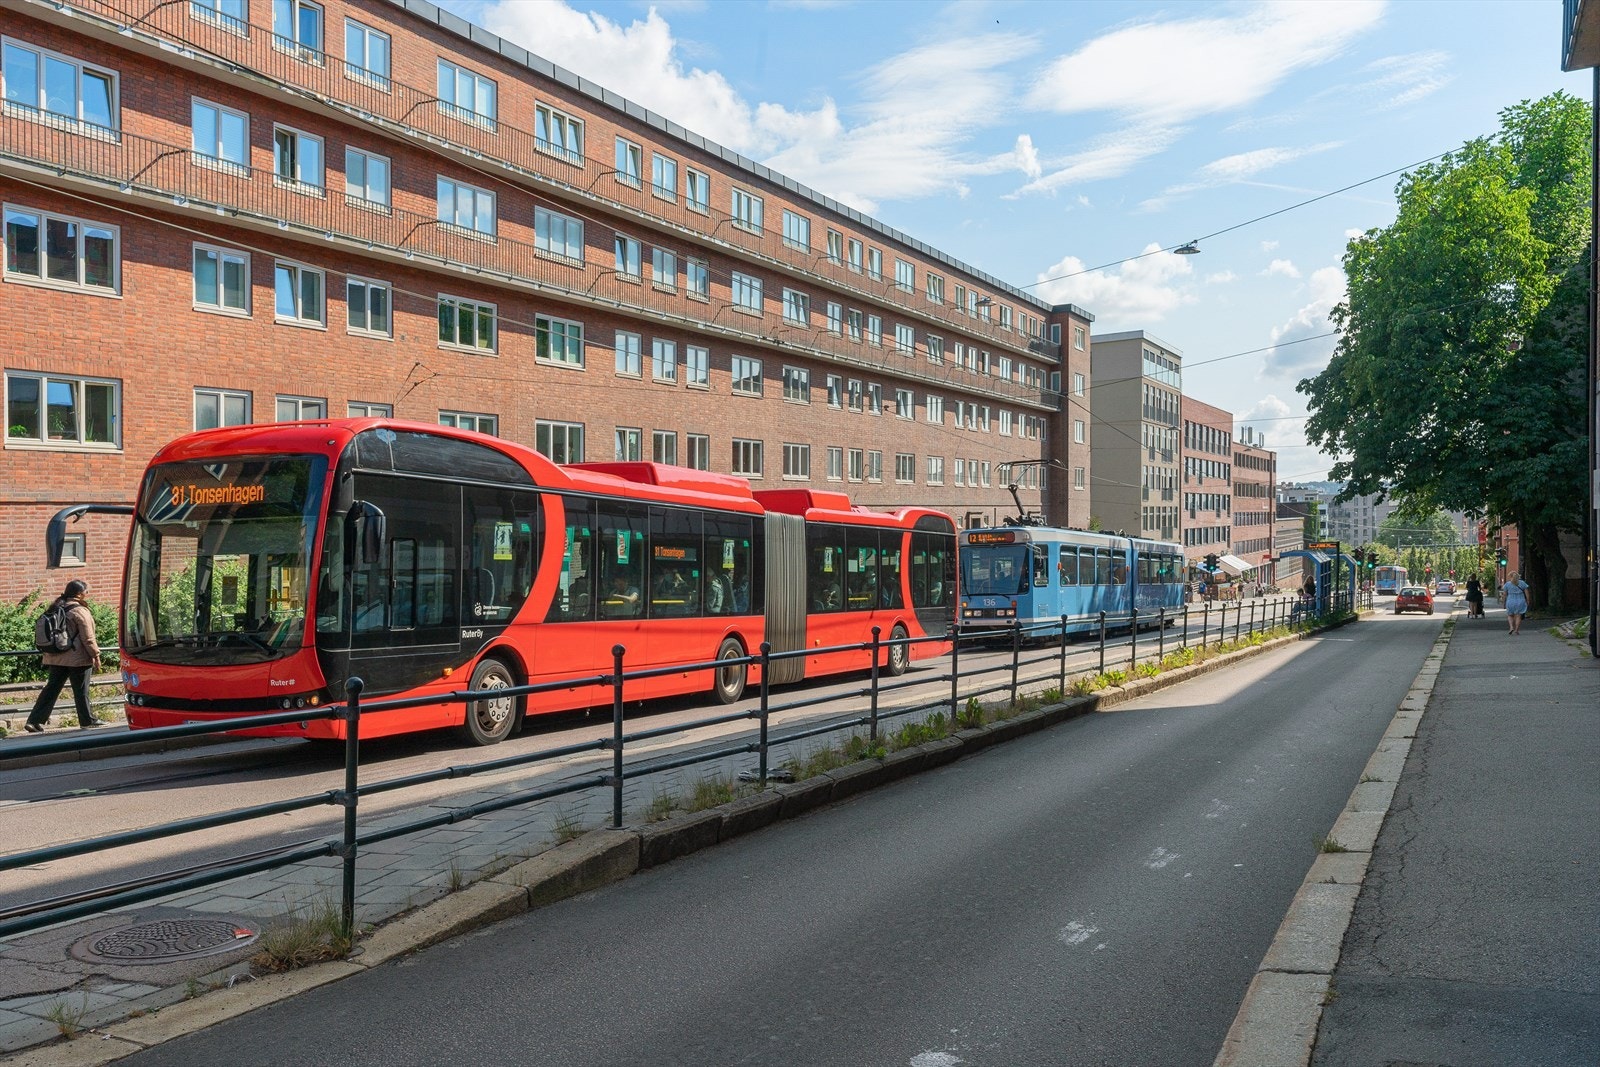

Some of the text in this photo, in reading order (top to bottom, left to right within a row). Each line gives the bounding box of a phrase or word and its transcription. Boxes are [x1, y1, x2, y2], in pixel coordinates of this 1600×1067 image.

[172, 483, 264, 505] 31 Tonsenhagen
[970, 534, 977, 543] 12
[983, 598, 996, 607] 136
